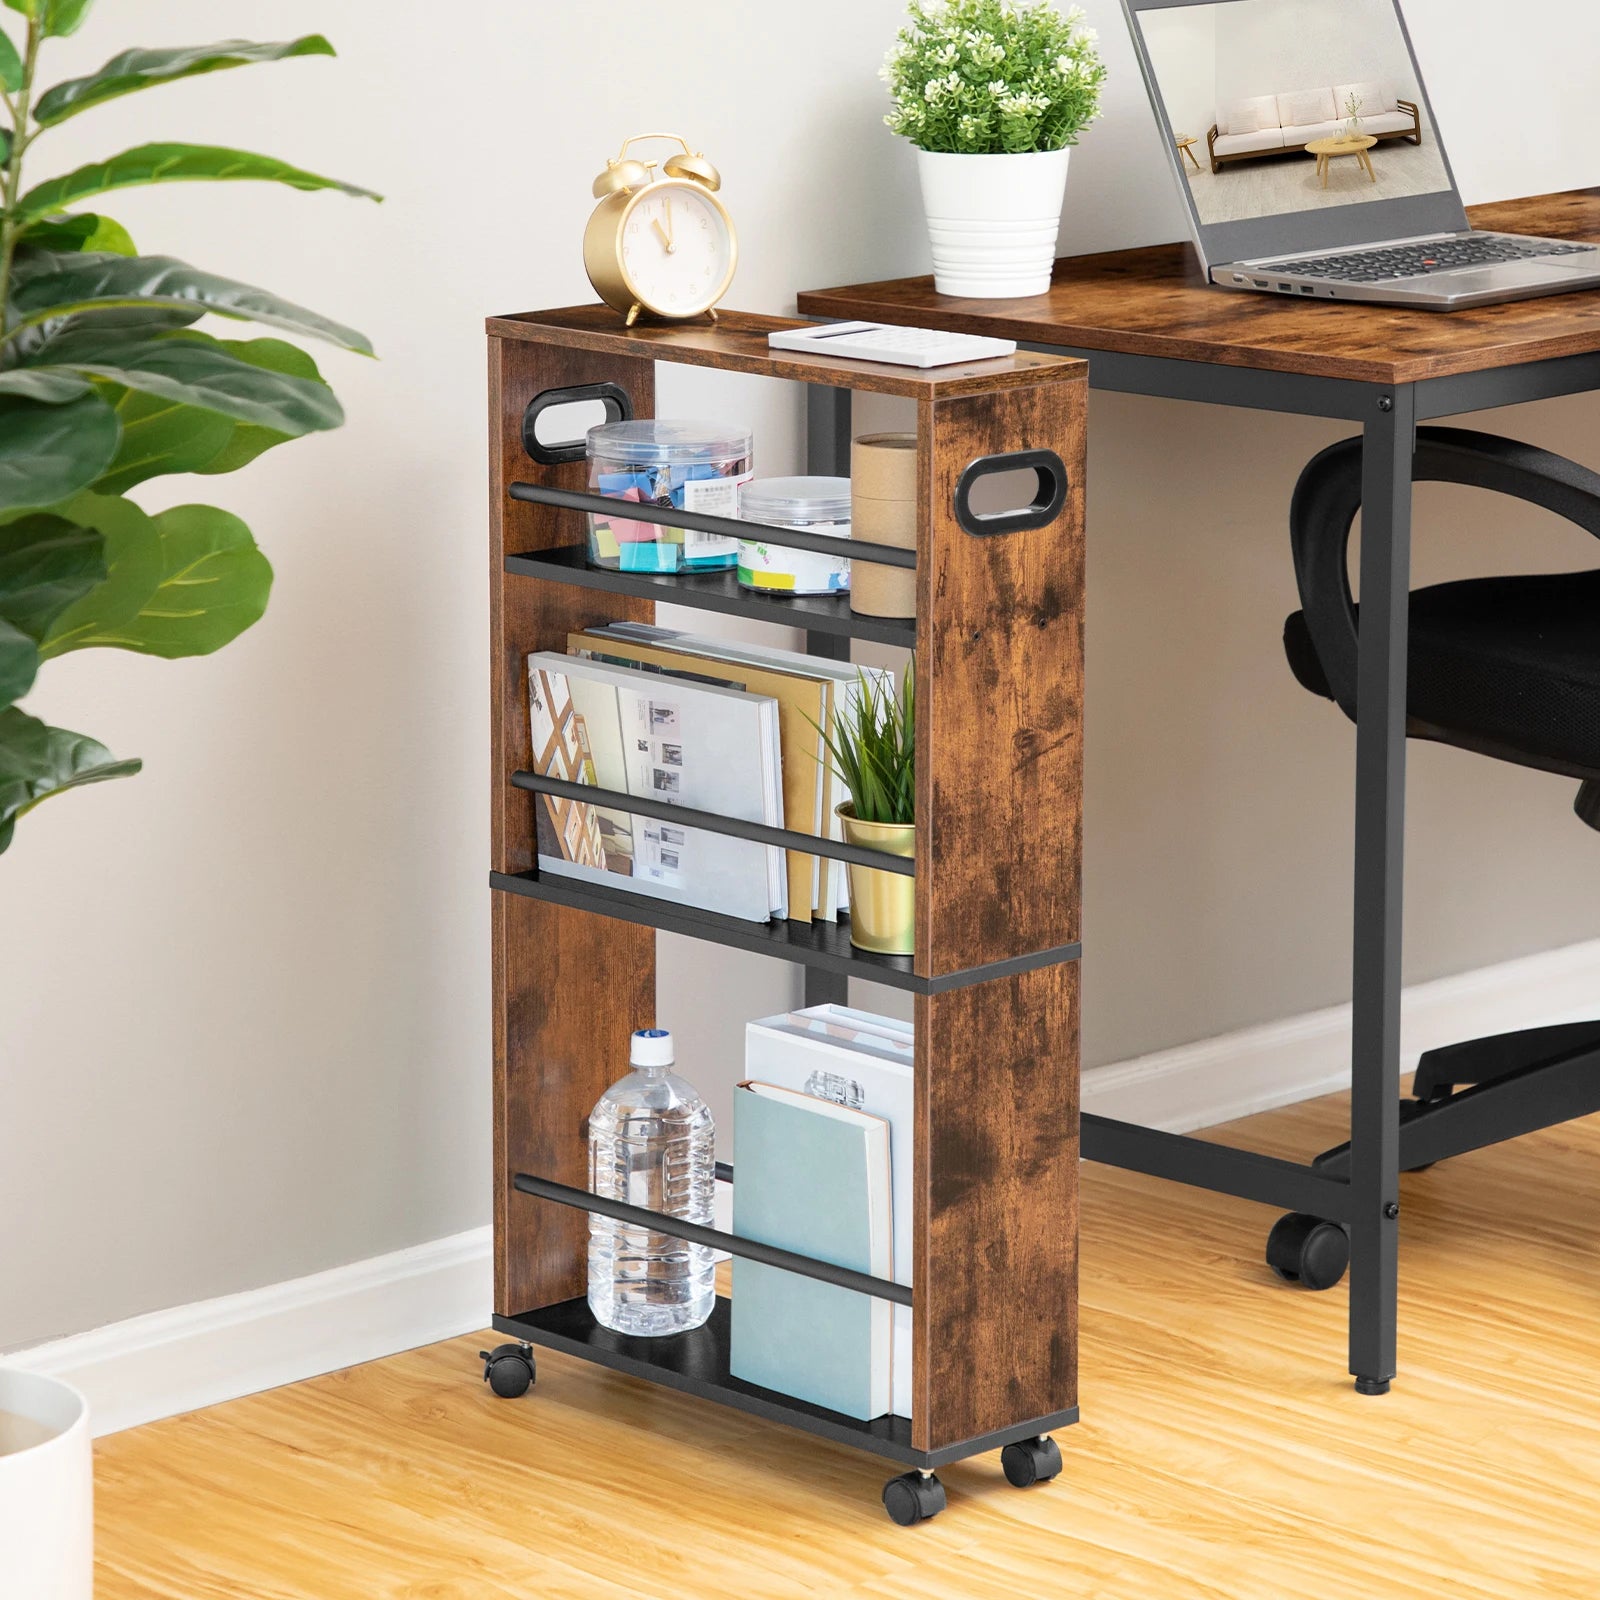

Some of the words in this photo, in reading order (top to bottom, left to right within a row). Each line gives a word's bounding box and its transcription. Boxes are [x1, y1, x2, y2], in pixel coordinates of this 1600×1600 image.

[642, 203, 651, 216] 11
[684, 201, 689, 213] 1
[700, 218, 707, 230] 2
